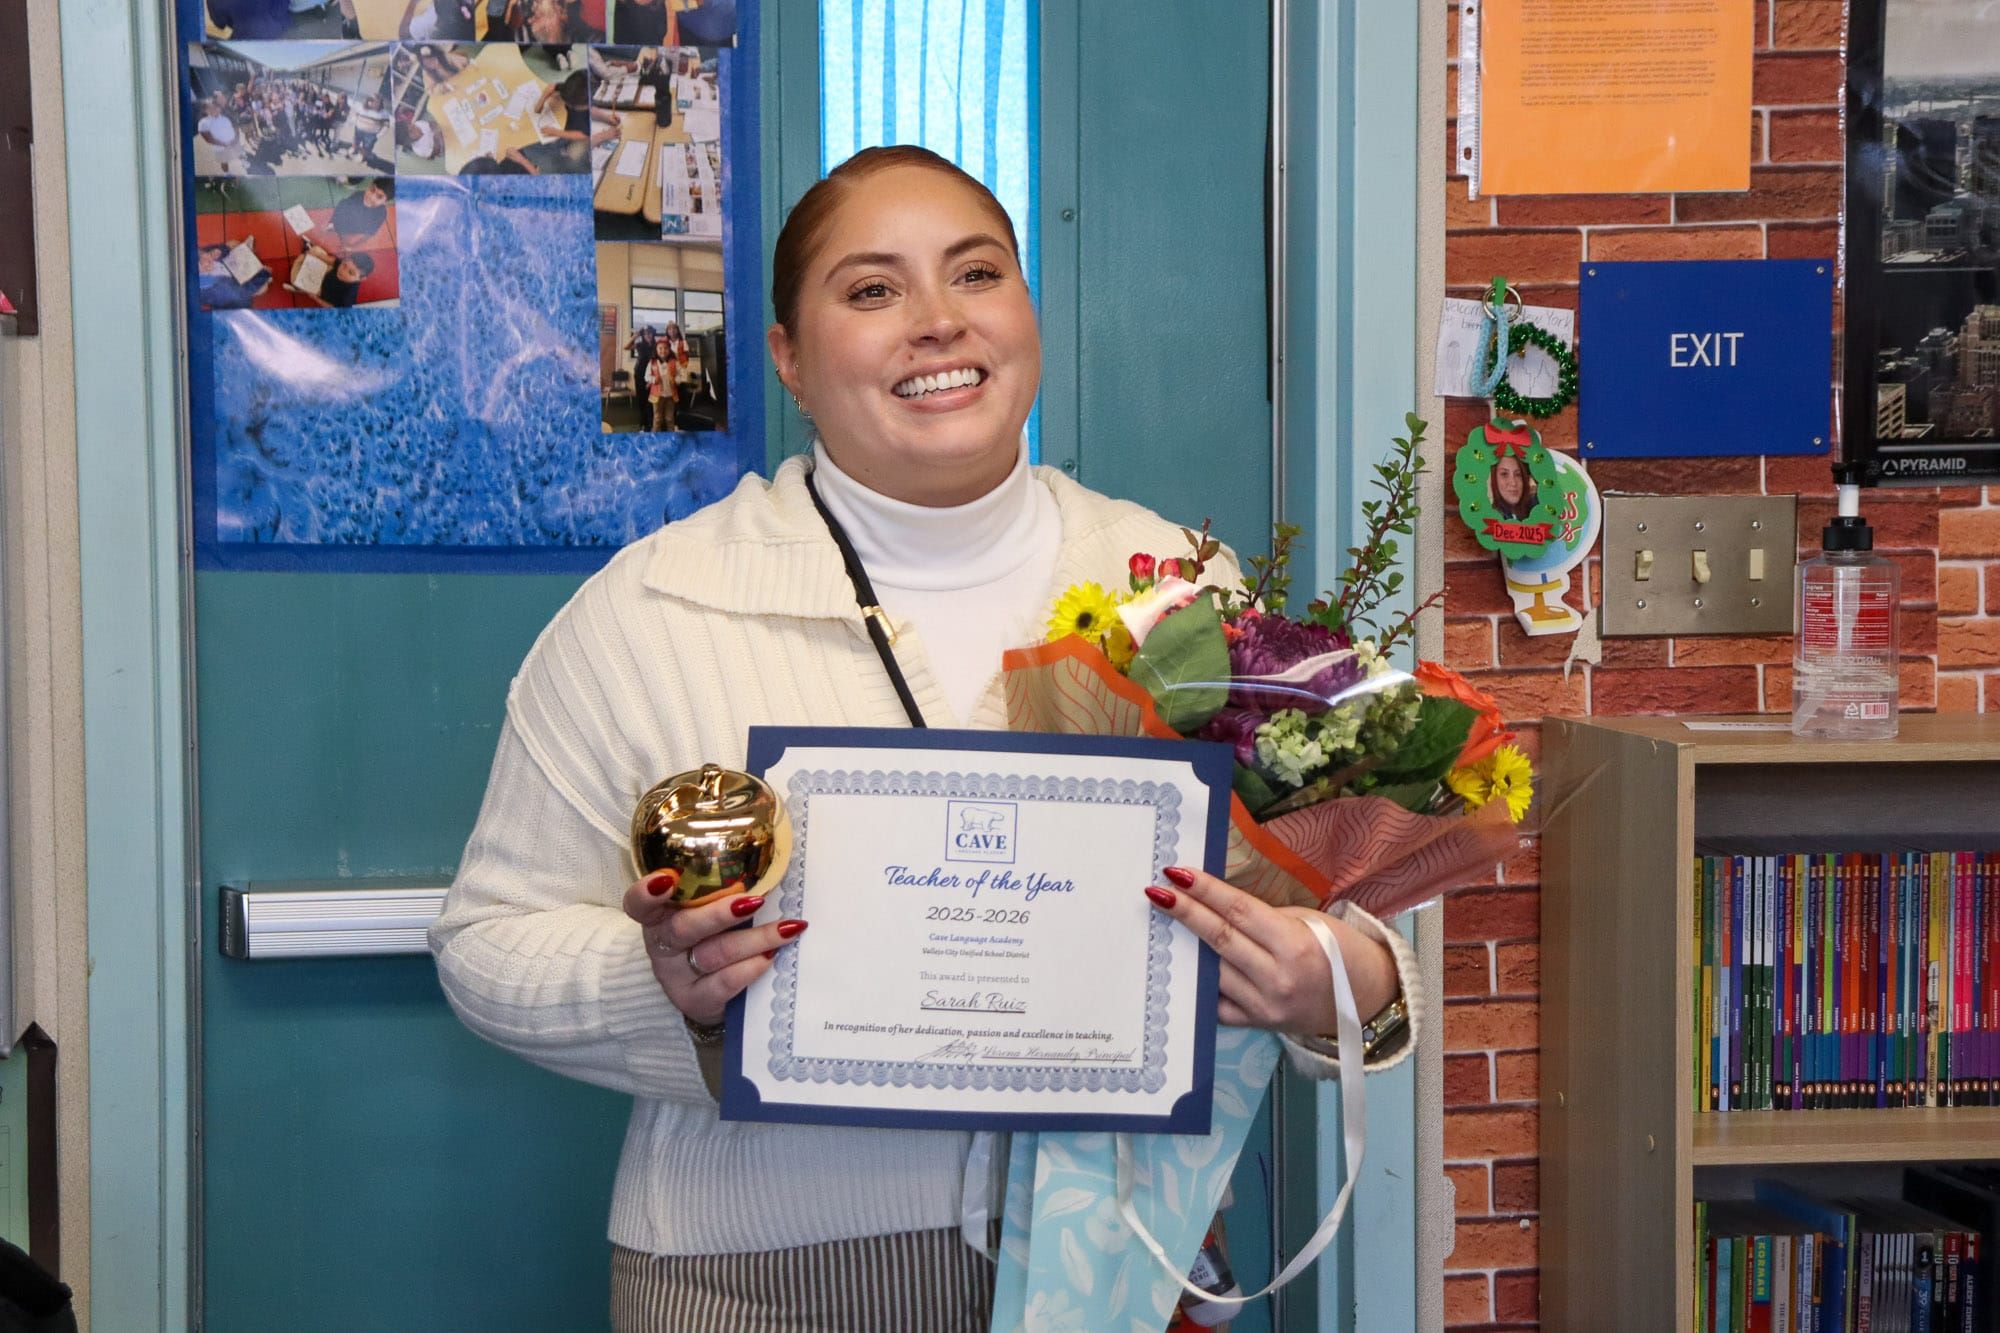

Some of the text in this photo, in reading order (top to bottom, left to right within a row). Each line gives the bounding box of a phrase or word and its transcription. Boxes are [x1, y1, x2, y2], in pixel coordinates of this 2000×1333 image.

[1670, 332, 1744, 367] EXIT
[1900, 458, 1966, 471] PYRAMID
[1519, 526, 1545, 543] 2025
[955, 833, 1007, 850] CAVE
[884, 865, 1075, 901] Teacher of the Year
[925, 906, 1031, 925] 2025-2026
[929, 933, 1024, 946] Cave Language Academy
[945, 948, 958, 957] City
[960, 949, 983, 959] Unified
[984, 950, 1004, 958] School
[1006, 950, 1030, 959] District
[920, 971, 1030, 985] This award is presented to
[920, 990, 1027, 1011] Sarah Ruiz
[824, 1021, 1115, 1043] In recognition of her dedication, passion and excellence in teaching.
[1757, 1242, 1767, 1296] KORMAN
[1918, 1289, 1928, 1306] 39
[1966, 1273, 1974, 1304] ALBERT
[1860, 1296, 1872, 1333] ESCAP
